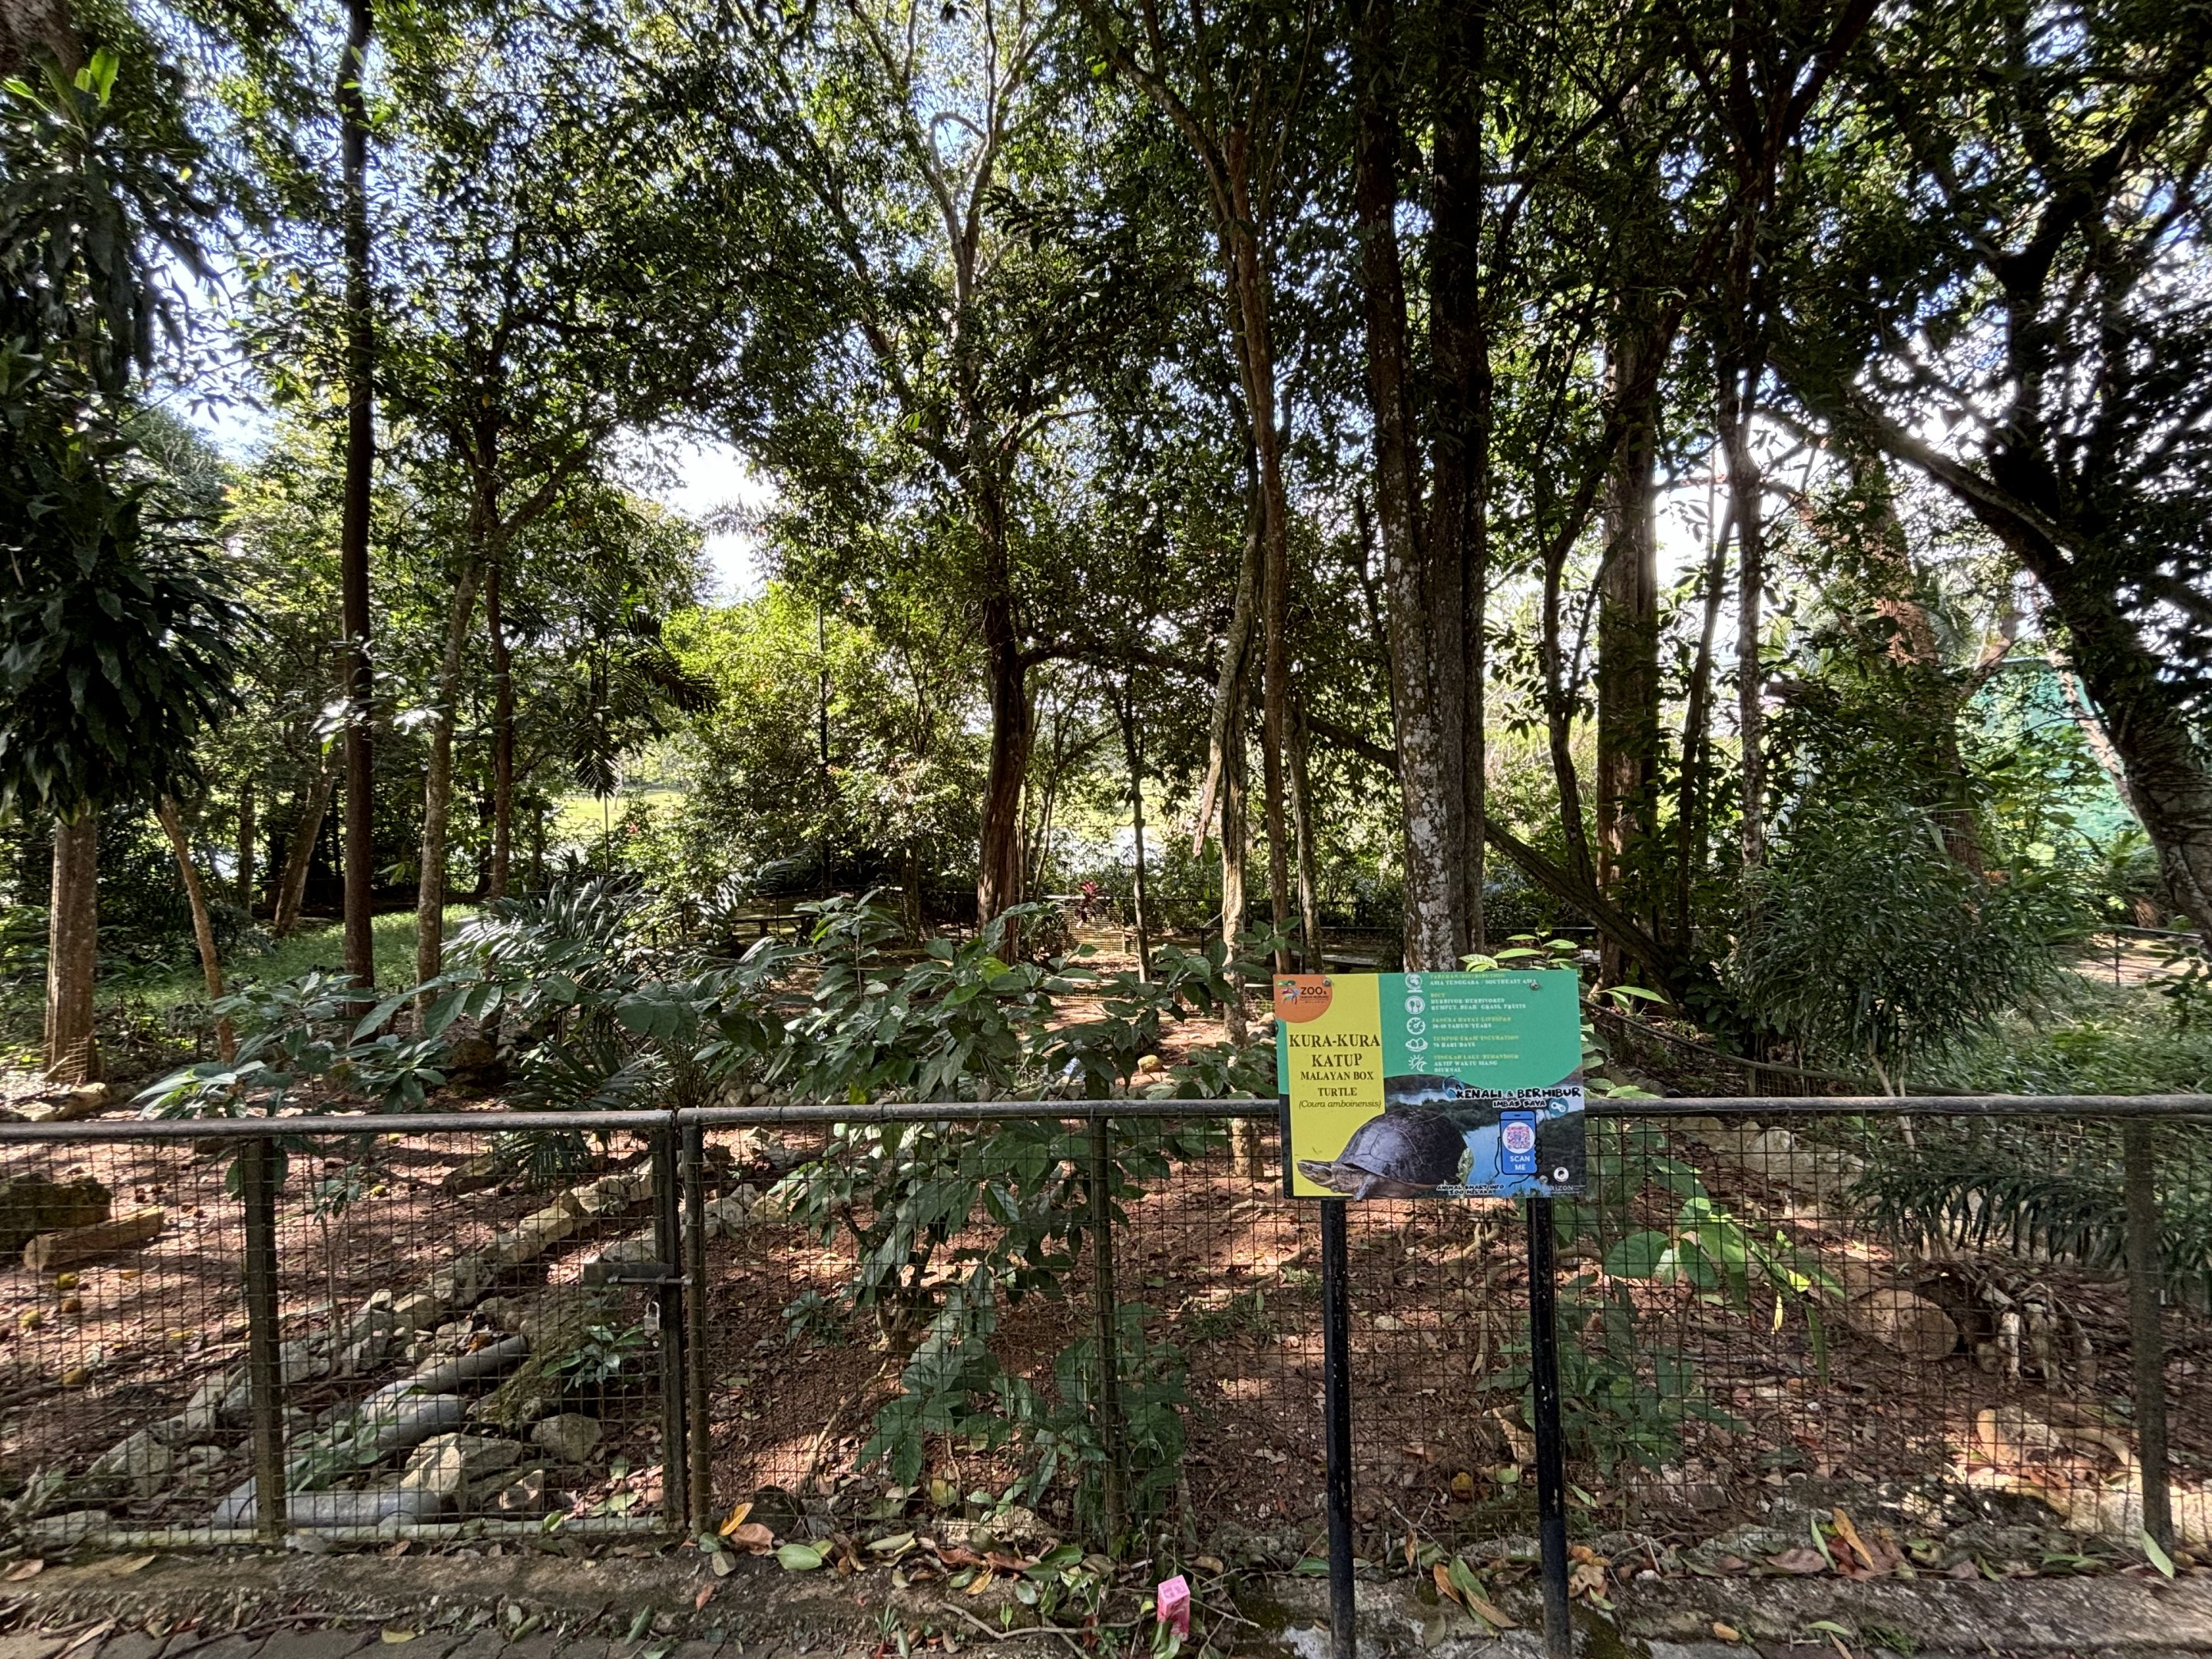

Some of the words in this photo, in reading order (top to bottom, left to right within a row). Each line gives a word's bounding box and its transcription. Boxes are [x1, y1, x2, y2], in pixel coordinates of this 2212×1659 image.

[1300, 986, 1323, 995] ZOO
[1290, 1034, 1380, 1048] KURA-KURA
[1312, 1053, 1363, 1067] KATUP
[1300, 1071, 1350, 1080] MALAYAN
[1353, 1071, 1374, 1080] BOX
[1318, 1088, 1357, 1096] TURTLE
[1456, 1088, 1502, 1098] KENALI
[1518, 1088, 1581, 1098] BERHIBUR
